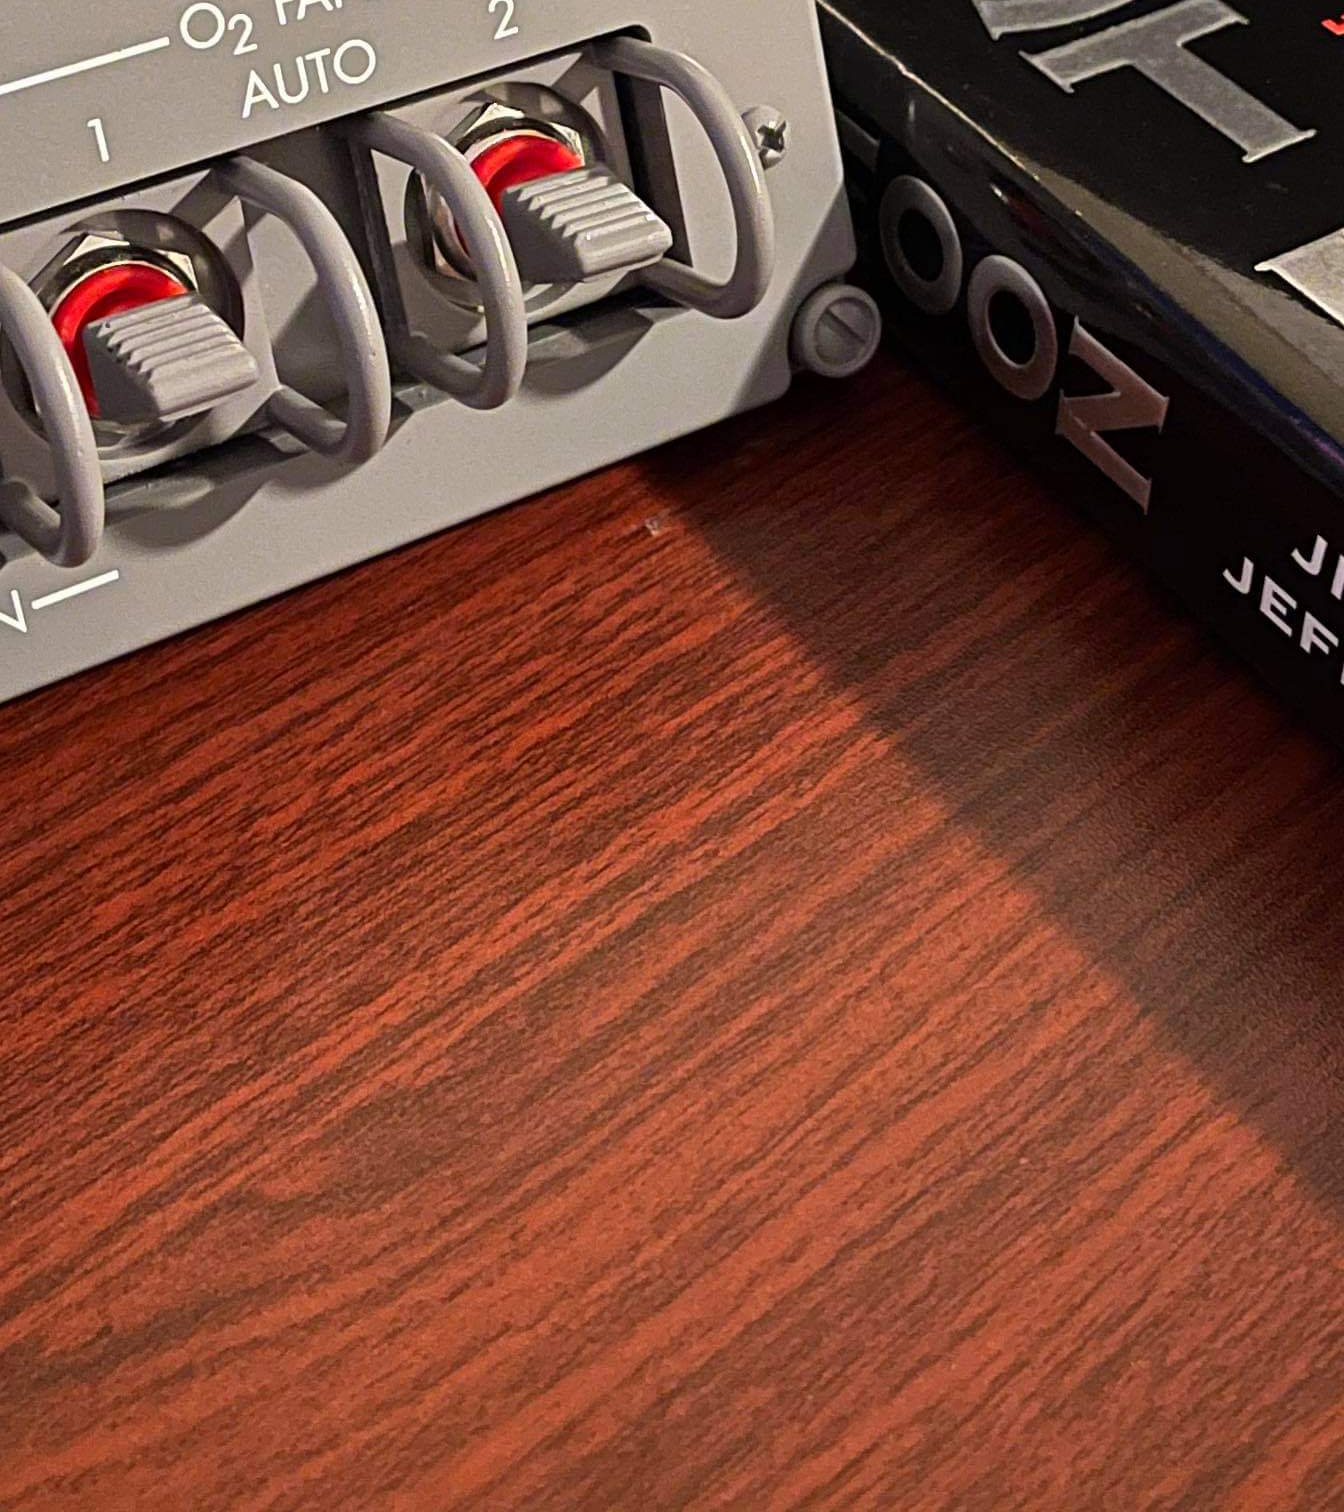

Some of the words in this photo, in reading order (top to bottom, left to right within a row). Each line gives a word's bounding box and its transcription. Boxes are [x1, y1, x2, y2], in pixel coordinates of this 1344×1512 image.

[86, 118, 110, 163] 1
[239, 39, 378, 120] AUTO
[837, 110, 1170, 515] OON
